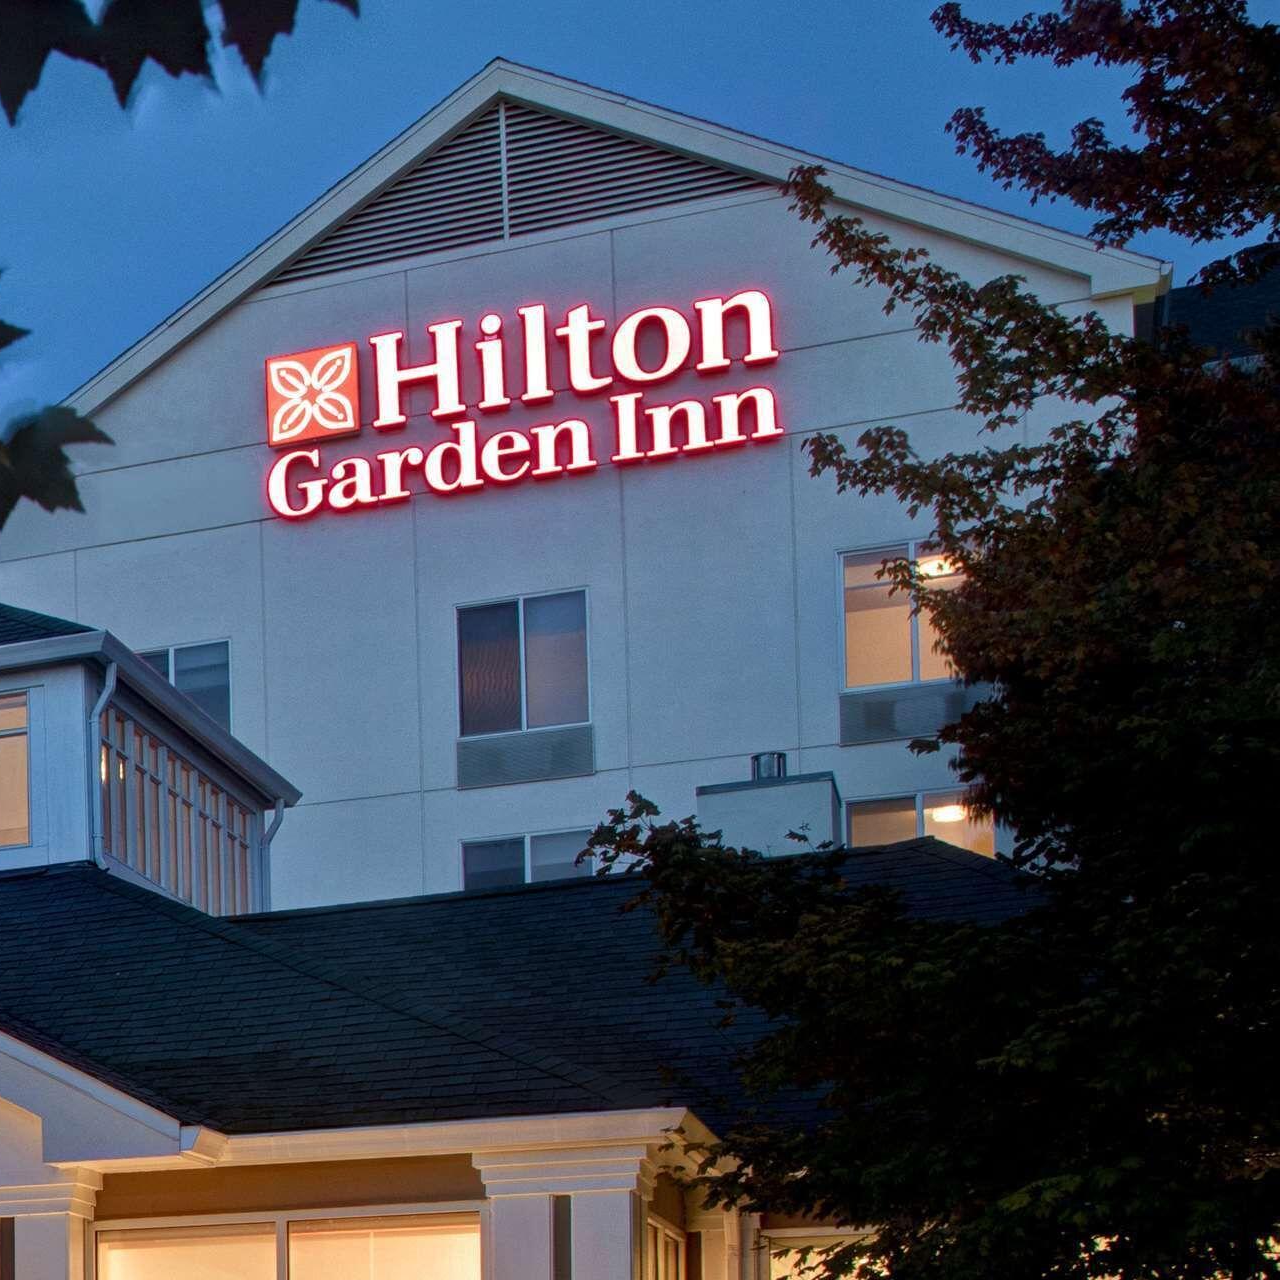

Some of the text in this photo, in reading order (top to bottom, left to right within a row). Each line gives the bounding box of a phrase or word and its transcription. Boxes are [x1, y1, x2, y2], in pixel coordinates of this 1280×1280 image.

[370, 289, 779, 429] Hilton
[267, 386, 784, 519] Garden Inn
